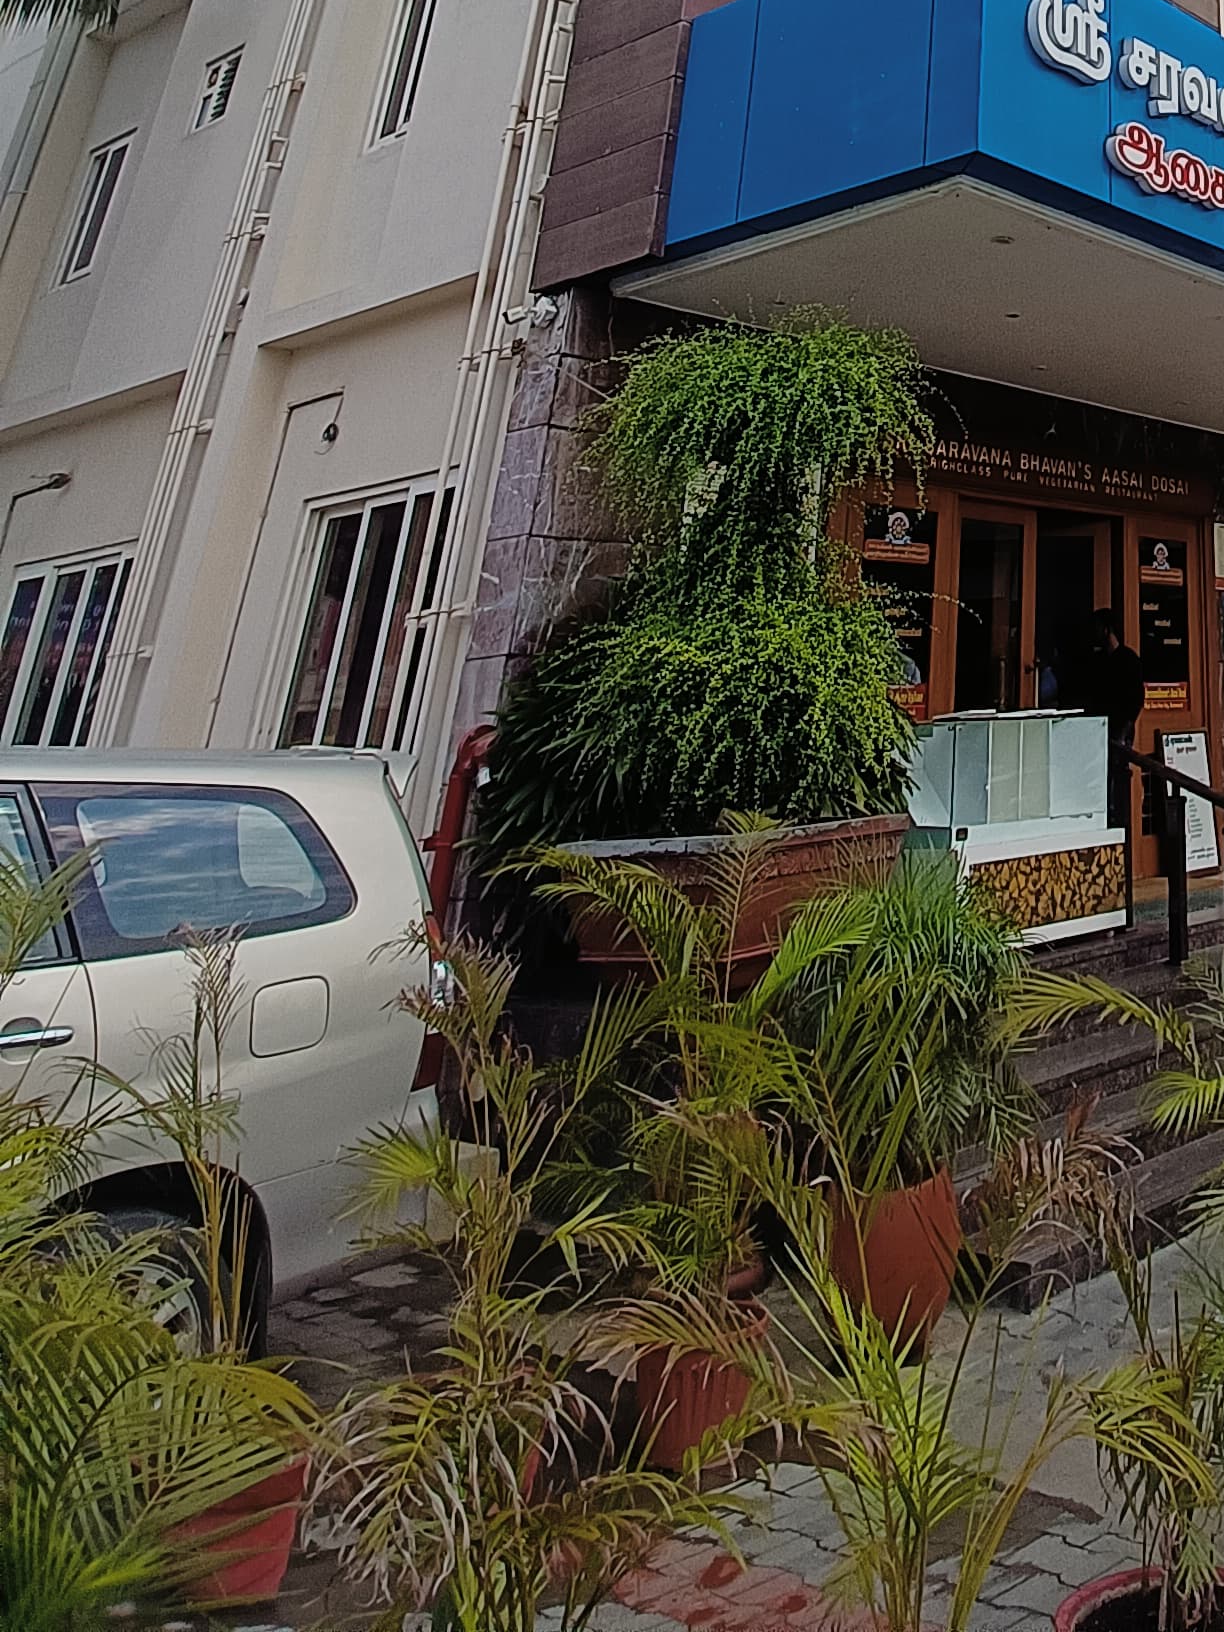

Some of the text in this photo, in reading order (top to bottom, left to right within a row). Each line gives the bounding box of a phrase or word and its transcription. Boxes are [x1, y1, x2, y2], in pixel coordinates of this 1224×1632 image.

[1003, 469, 1028, 483] PURE
[1040, 475, 1096, 493] VEGETARIAN
[1105, 486, 1158, 502] RESTAURANT
[1020, 452, 1092, 480] BHAVAN'S
[1101, 467, 1143, 489] AASAI
[1151, 475, 1189, 496] DOSAI
